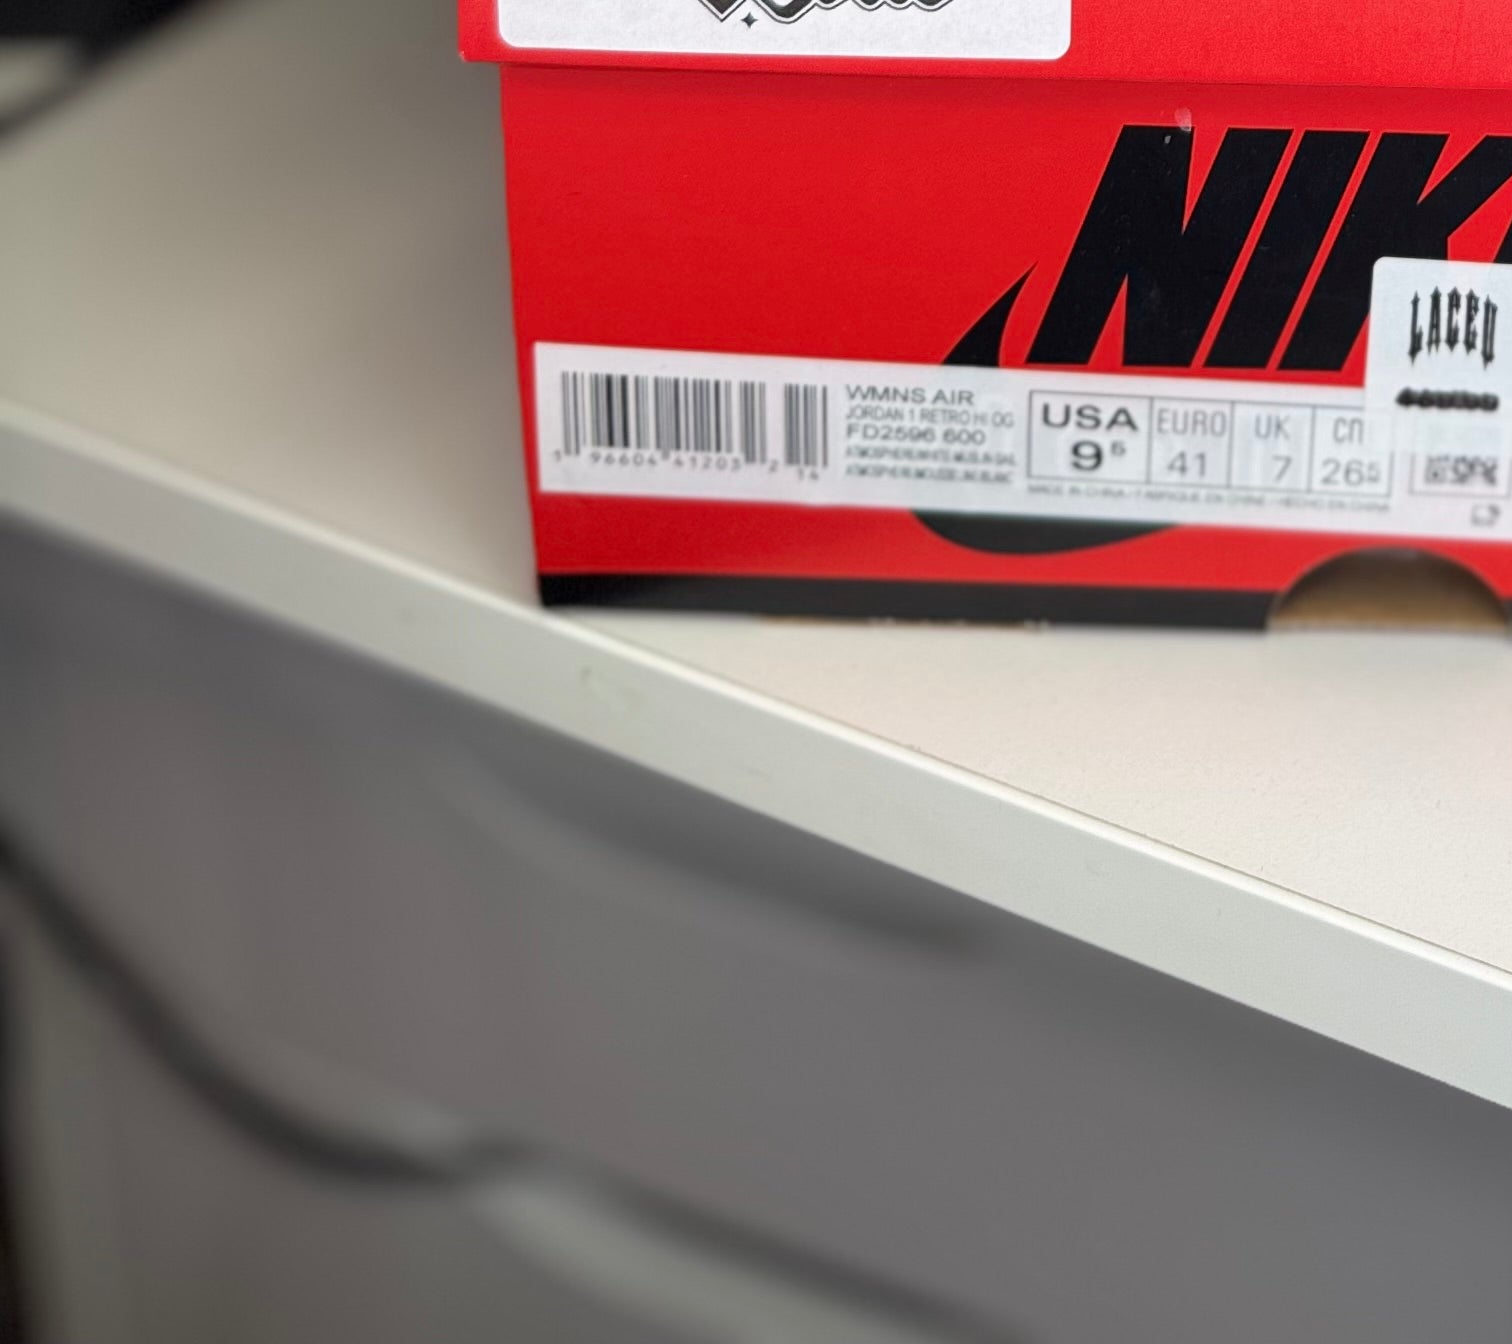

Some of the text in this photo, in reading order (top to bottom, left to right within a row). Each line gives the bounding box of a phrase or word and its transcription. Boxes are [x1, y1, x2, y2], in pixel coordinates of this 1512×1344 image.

[846, 383, 975, 406] WMNS AIR
[847, 404, 904, 421] JORDAN
[920, 407, 970, 426] RETRO
[991, 411, 1015, 428] OG
[1042, 402, 1139, 432] USA
[1157, 408, 1227, 438] EURO
[1255, 414, 1290, 440] UK
[846, 423, 986, 446] FD2596 600
[1167, 450, 1207, 478] 41
[1272, 454, 1294, 483] 7
